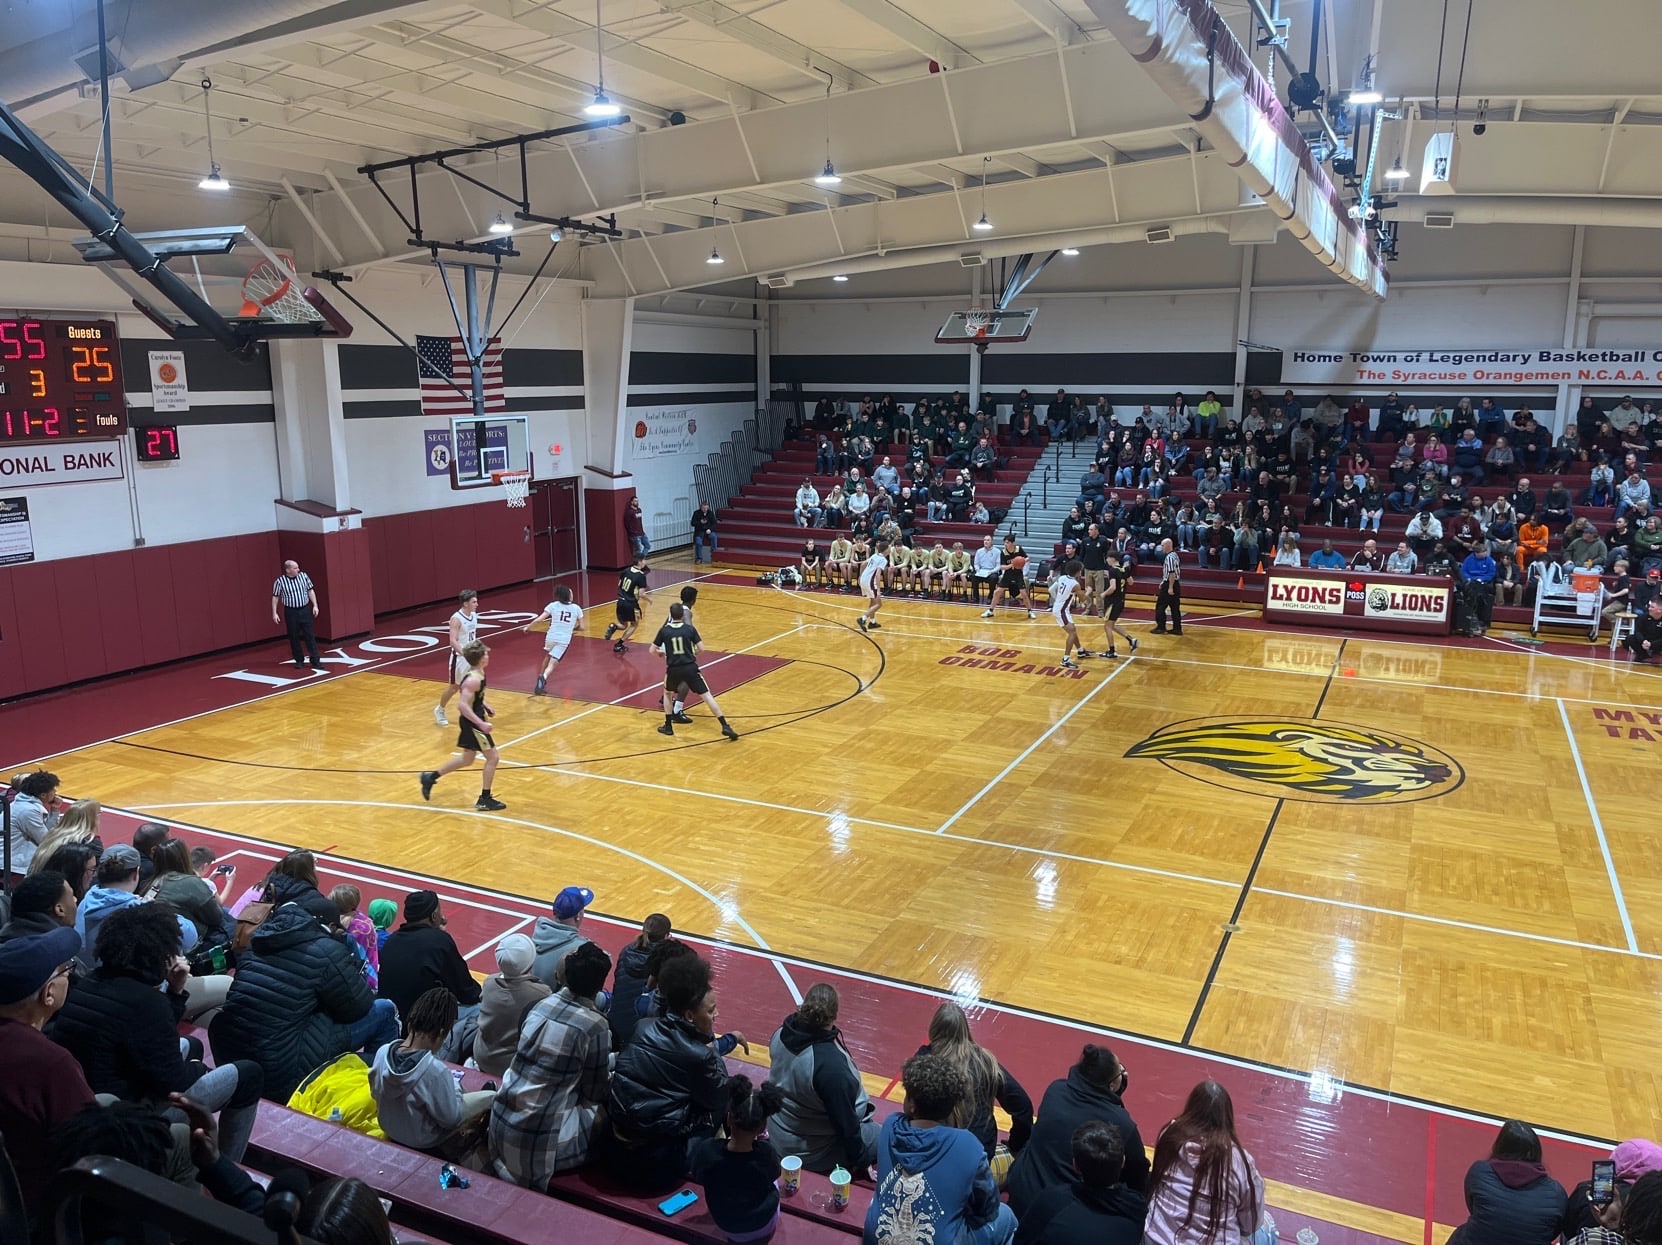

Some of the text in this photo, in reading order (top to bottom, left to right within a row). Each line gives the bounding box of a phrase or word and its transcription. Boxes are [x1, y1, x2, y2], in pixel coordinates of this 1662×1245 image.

[0, 323, 45, 359] 55
[68, 326, 101, 339] Guests
[72, 347, 113, 382] 25
[1293, 352, 1343, 363] Home
[1349, 352, 1397, 363] Town
[1403, 352, 1422, 363] of
[1428, 351, 1532, 365] Legendary
[1538, 351, 1646, 362] Basketball
[29, 369, 47, 397] 3
[1356, 369, 1386, 380] The
[1391, 369, 1467, 382] Syracuse
[1473, 369, 1571, 382] Orangemen
[1577, 369, 1649, 380] N.C.A.A.
[96, 414, 118, 426] fouls
[147, 430, 175, 455] 27
[428, 433, 464, 442] SECTN
[466, 432, 472, 440] V
[0, 451, 115, 475] ONAL BANK
[1271, 584, 1342, 605] LYONS
[1346, 591, 1365, 600] POSS
[1389, 593, 1445, 613] LIONS
[560, 610, 572, 623] 12
[210, 610, 539, 689] LYONS
[671, 636, 685, 655] 11
[957, 645, 1022, 659] BOB
[937, 656, 1090, 680] OHMANN
